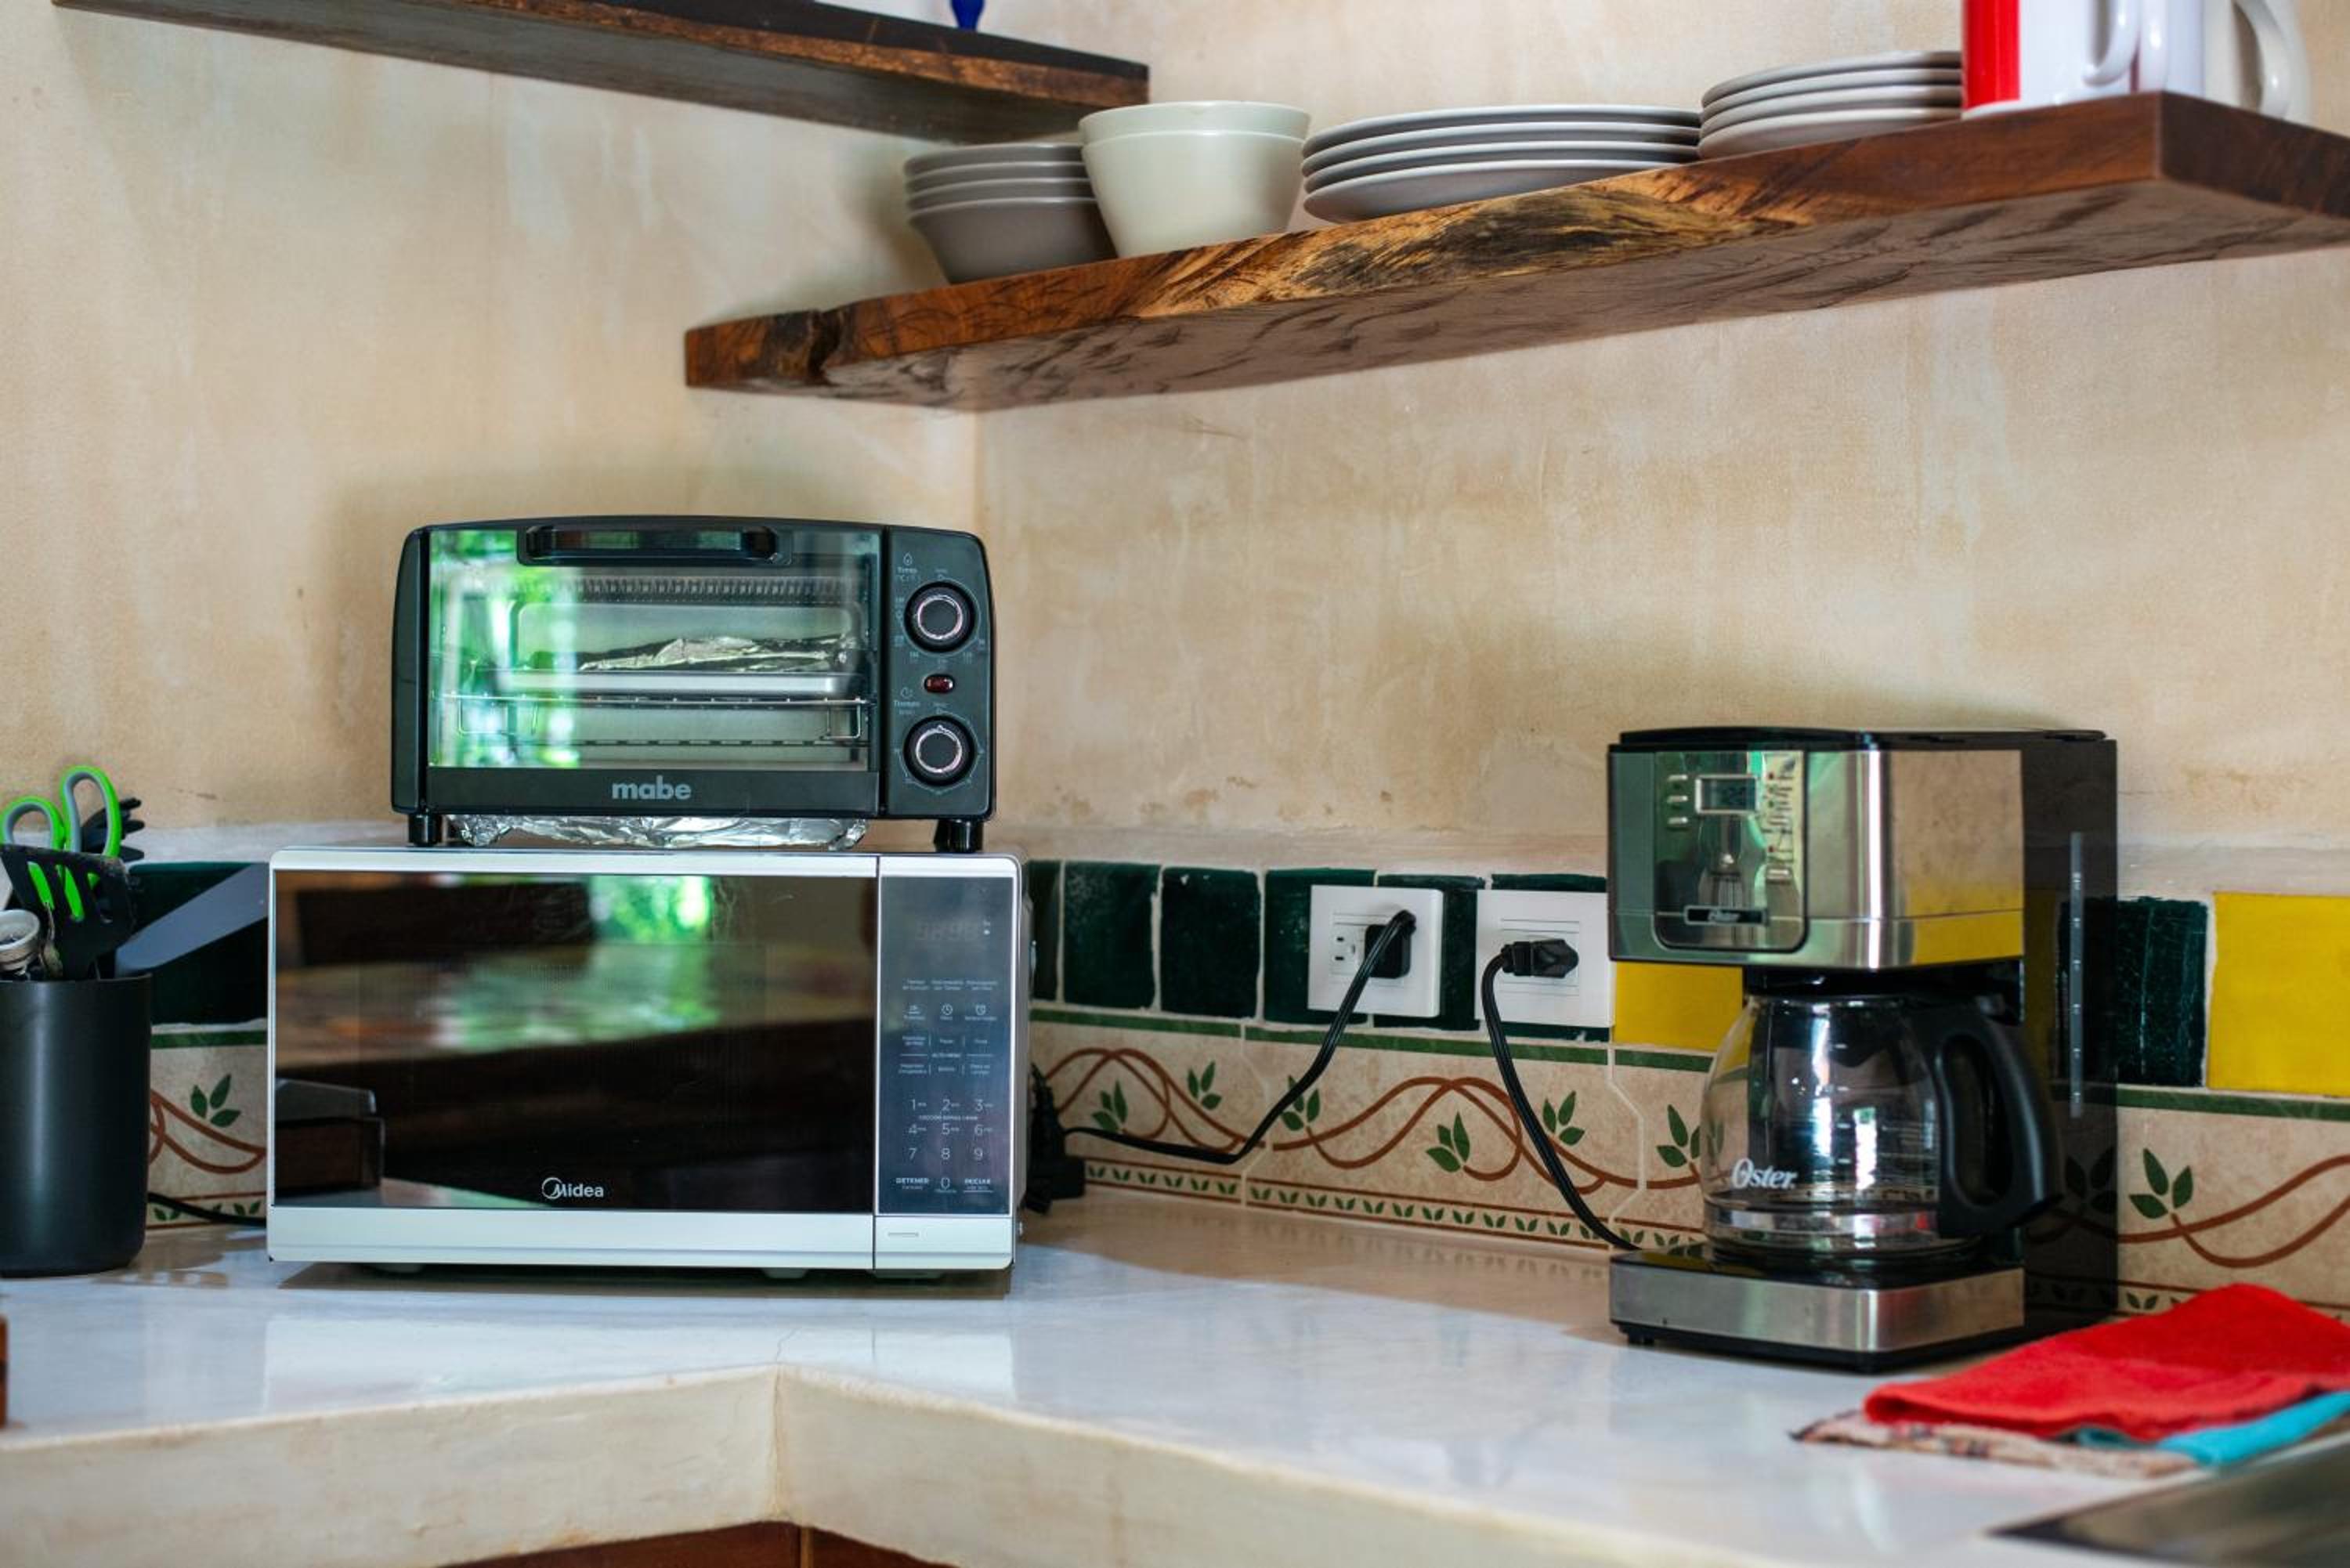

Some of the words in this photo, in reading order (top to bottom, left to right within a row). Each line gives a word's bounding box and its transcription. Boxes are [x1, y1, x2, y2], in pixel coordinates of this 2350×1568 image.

[612, 775, 691, 800] mabe
[909, 1099, 916, 1111] 1
[942, 1099, 950, 1111] 2
[974, 1099, 984, 1111] 3
[908, 1123, 917, 1135] 4
[942, 1122, 950, 1136] 5
[974, 1124, 984, 1136] 6
[909, 1147, 917, 1160] 7
[941, 1147, 950, 1161] 8
[974, 1147, 983, 1161] 9
[1731, 1158, 1798, 1189] Oster
[541, 1177, 604, 1199] Midea
[941, 1176, 950, 1190] 0
